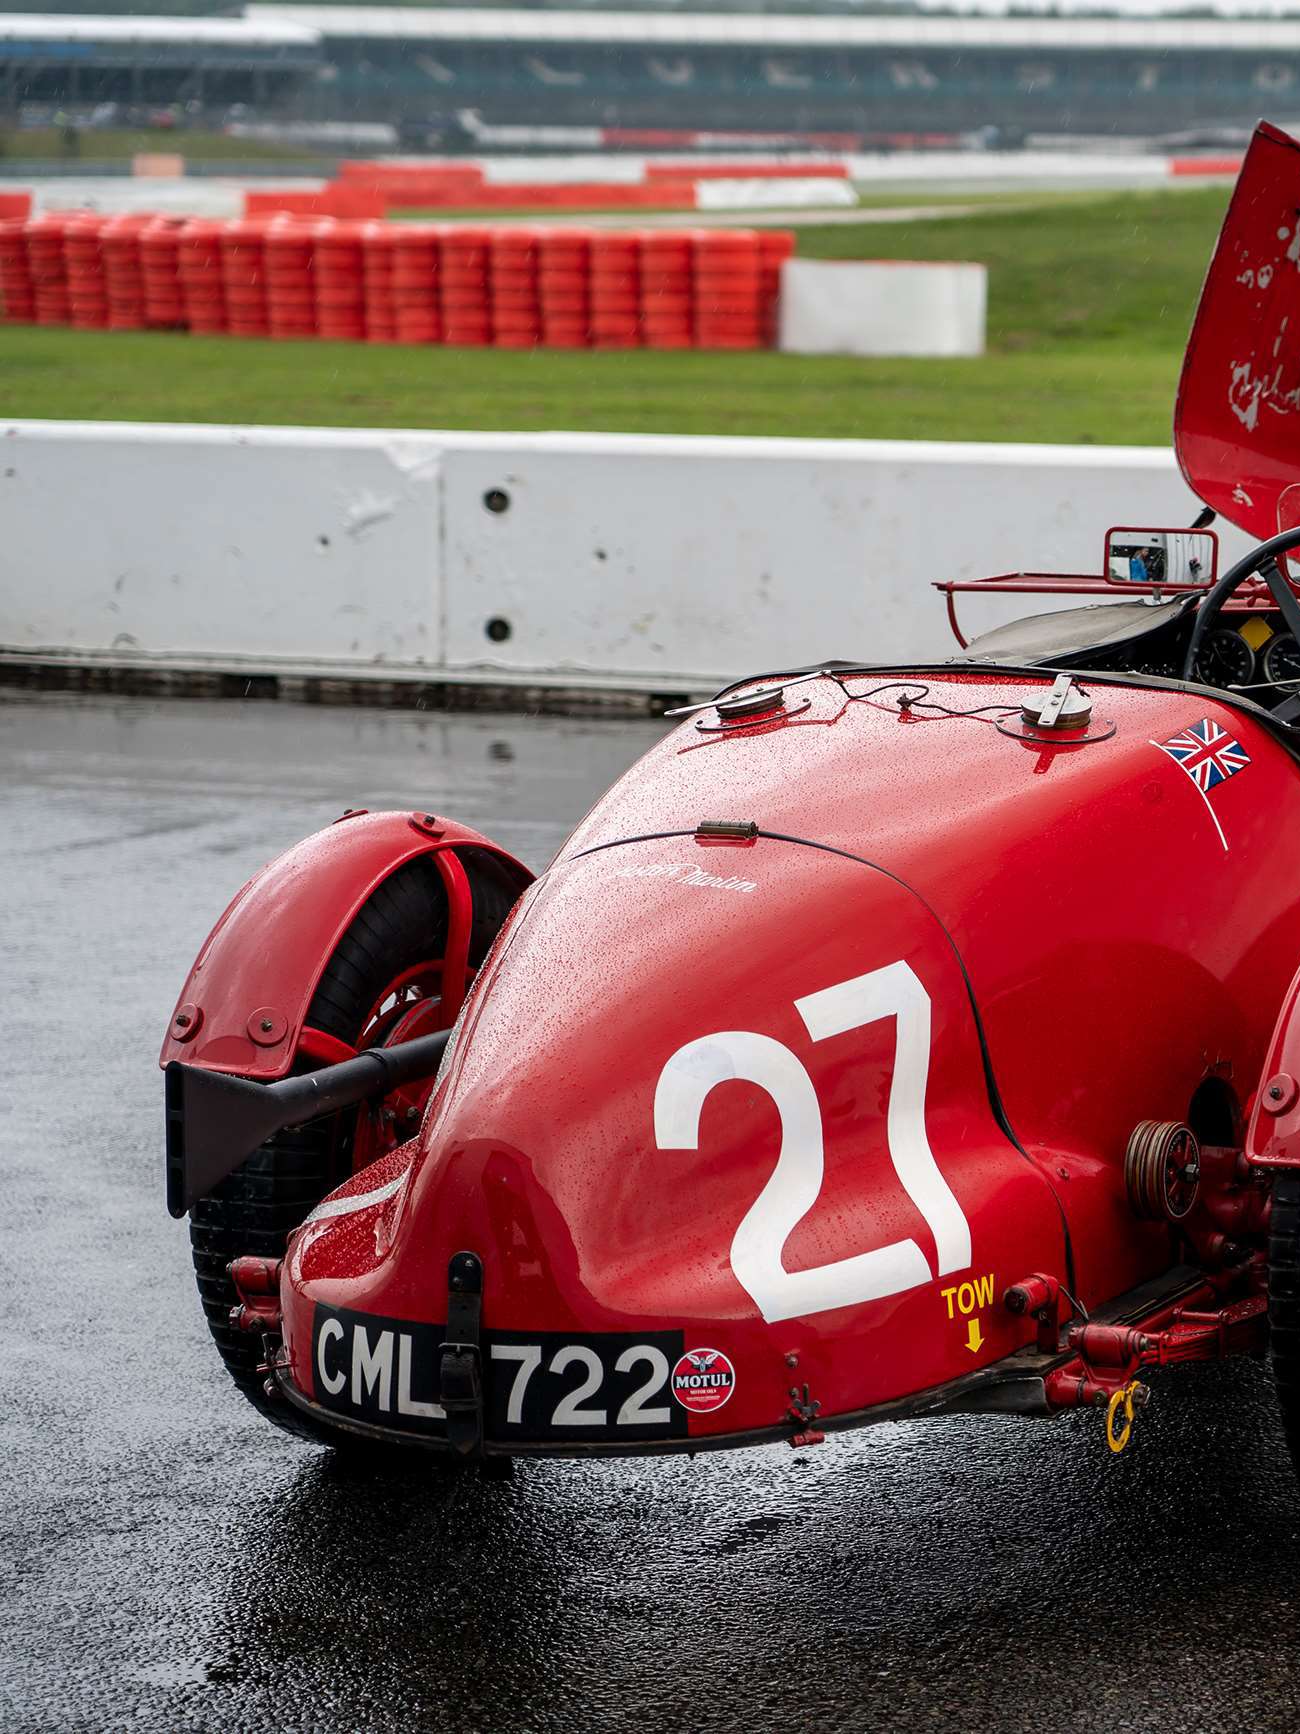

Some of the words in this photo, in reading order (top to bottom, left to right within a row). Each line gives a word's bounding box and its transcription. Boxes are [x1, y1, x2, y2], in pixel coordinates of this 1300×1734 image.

[664, 863, 758, 893] Martin
[653, 959, 972, 1325] 27
[940, 1273, 995, 1320] TOW
[317, 1317, 448, 1420] CML
[490, 1344, 672, 1427] 722
[675, 1373, 730, 1389] MOTUL
